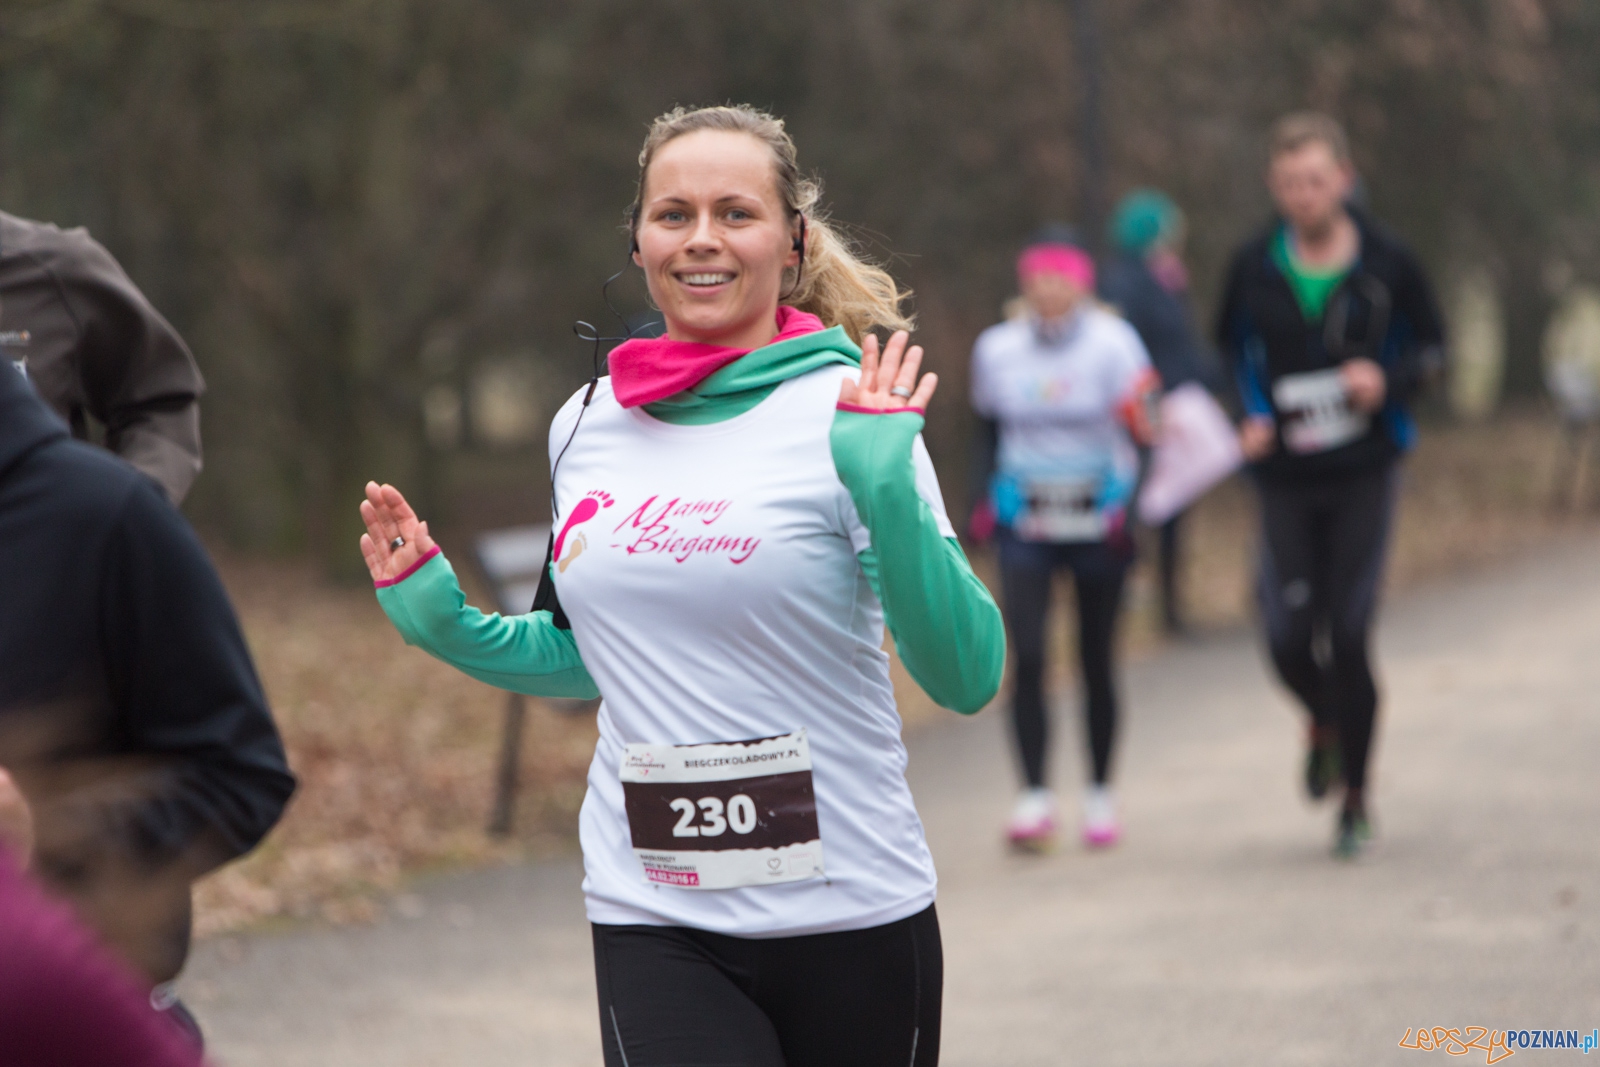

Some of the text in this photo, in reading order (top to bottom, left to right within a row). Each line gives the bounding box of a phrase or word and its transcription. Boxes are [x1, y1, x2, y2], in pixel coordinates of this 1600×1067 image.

[613, 494, 733, 534] Mamy
[684, 749, 800, 769] BIEGCZEKOLADOWY.PL
[670, 794, 757, 837] 230
